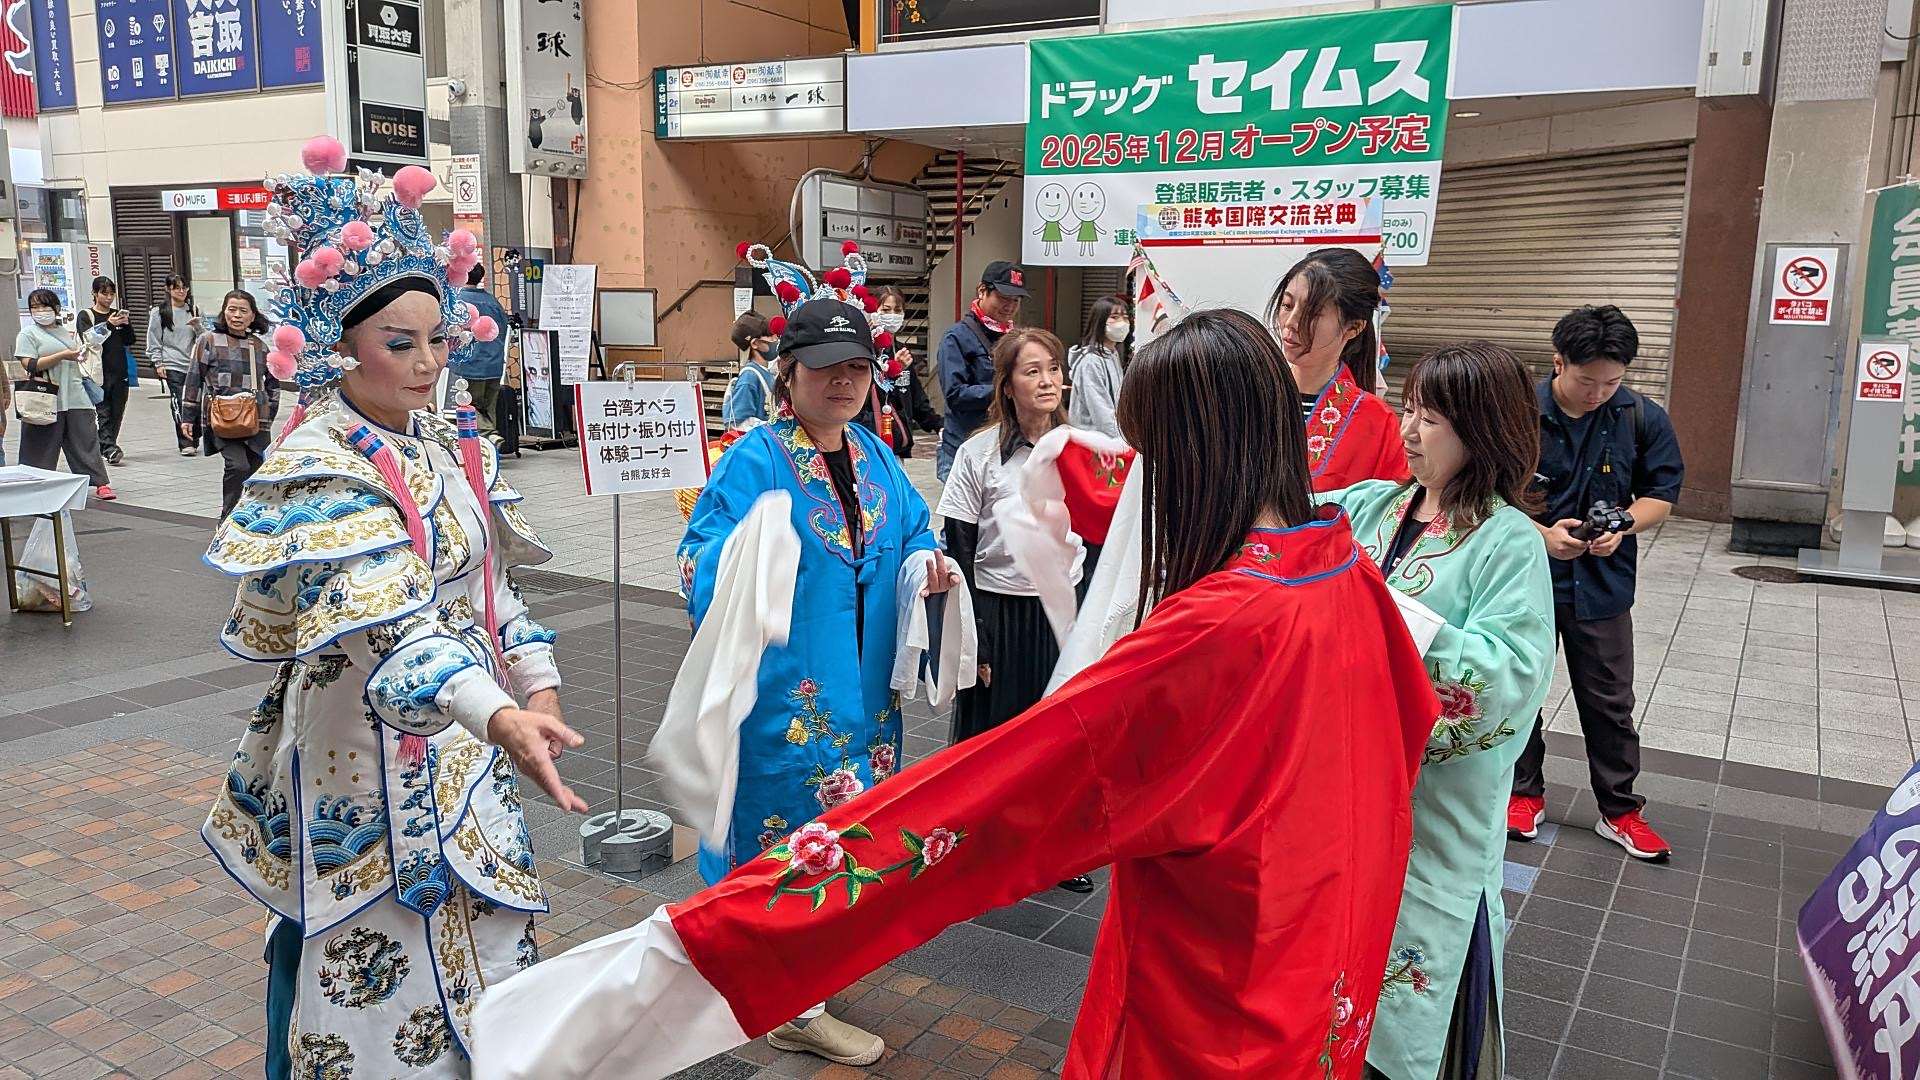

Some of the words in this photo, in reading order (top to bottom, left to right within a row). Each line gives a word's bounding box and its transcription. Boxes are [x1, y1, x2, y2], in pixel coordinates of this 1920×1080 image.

[367, 23, 413, 44] 買取大吉
[193, 57, 237, 75] DAIKICHI
[349, 50, 357, 63] 1F
[668, 76, 678, 85] 3F
[1041, 75, 1173, 119] ドラッグ
[1188, 39, 1430, 115] セイムス
[668, 98, 679, 108] 2F
[370, 119, 418, 139] ROISE
[670, 122, 679, 130] 1F
[1040, 113, 1431, 168] 2025年12月オープン予定
[185, 195, 207, 205] MUFG
[227, 192, 268, 204] 三菱UFJ銀行
[1154, 174, 1431, 204] 登録販売者・スタッフ募集
[1183, 203, 1358, 229] 熊本国際交流祭典
[1777, 307, 1824, 316] ポイ捨て禁止
[603, 398, 676, 417] 台湾オペラ
[587, 420, 696, 441] 着付け・振り付け
[600, 443, 689, 464] 体験コーナー
[621, 467, 671, 481] 台熊友好会
